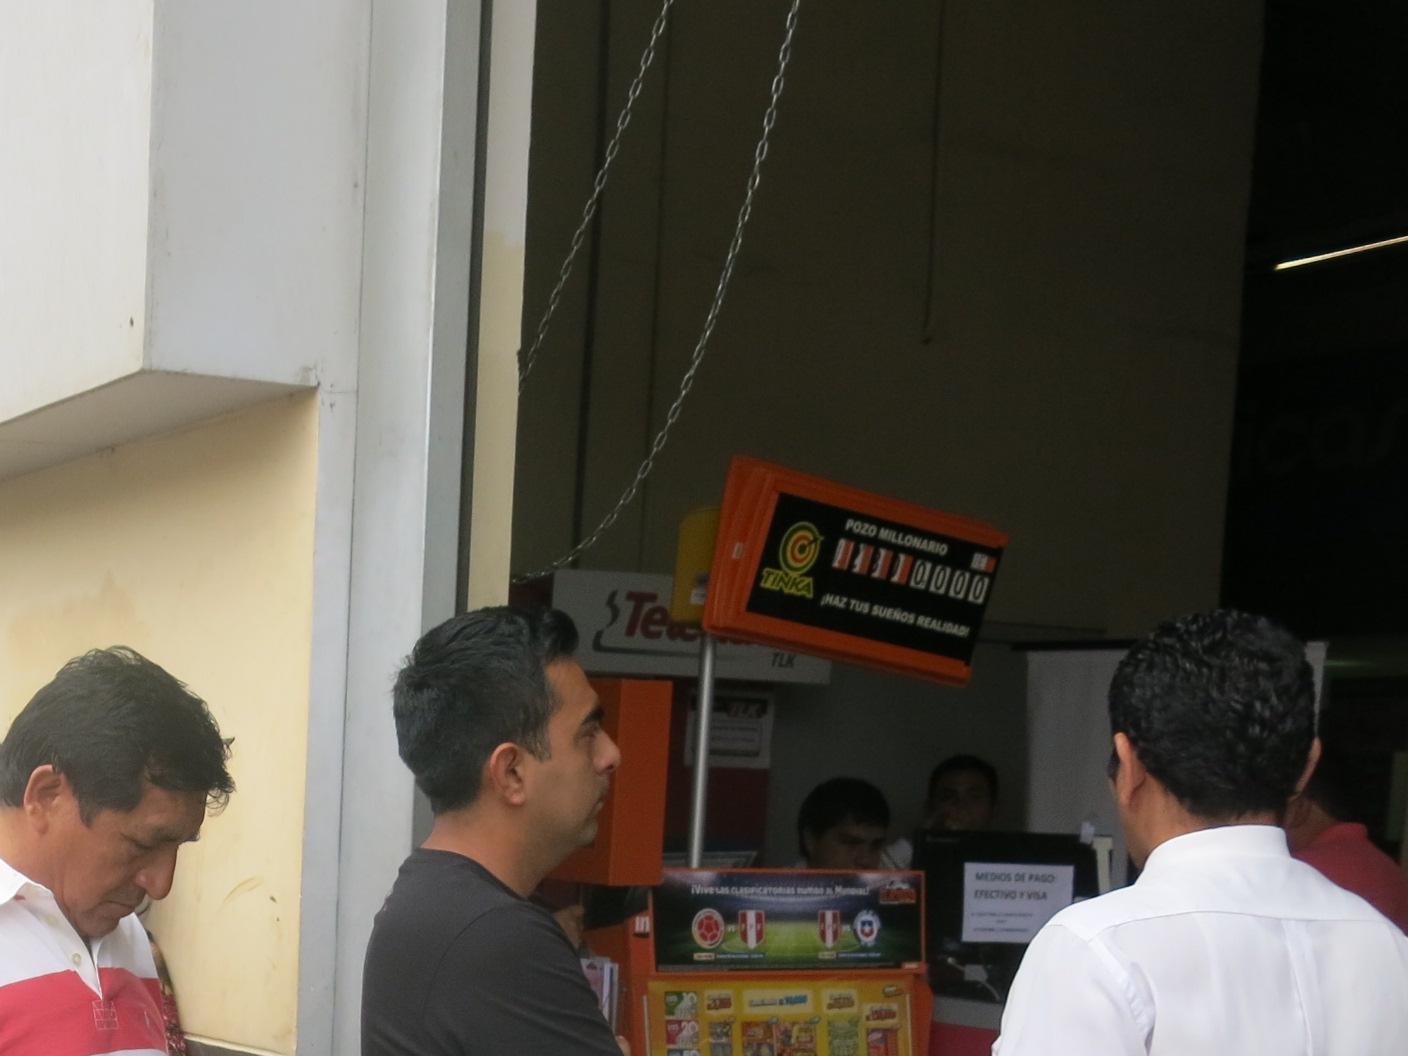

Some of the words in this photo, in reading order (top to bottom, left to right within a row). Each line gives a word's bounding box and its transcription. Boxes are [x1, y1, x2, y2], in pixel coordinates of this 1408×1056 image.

[845, 518, 877, 538] POZO
[878, 525, 949, 557] MILLONARIO
[759, 567, 814, 599] TINKA
[849, 599, 870, 615] TUS
[871, 604, 916, 626] SUEÑOS
[917, 614, 971, 639] REALIDAD!
[771, 652, 797, 668] TLK
[975, 872, 1012, 883] MEDIOS
[1014, 872, 1025, 883] DE
[974, 889, 1018, 900] EFECTIVO
[1027, 890, 1048, 900] VISA
